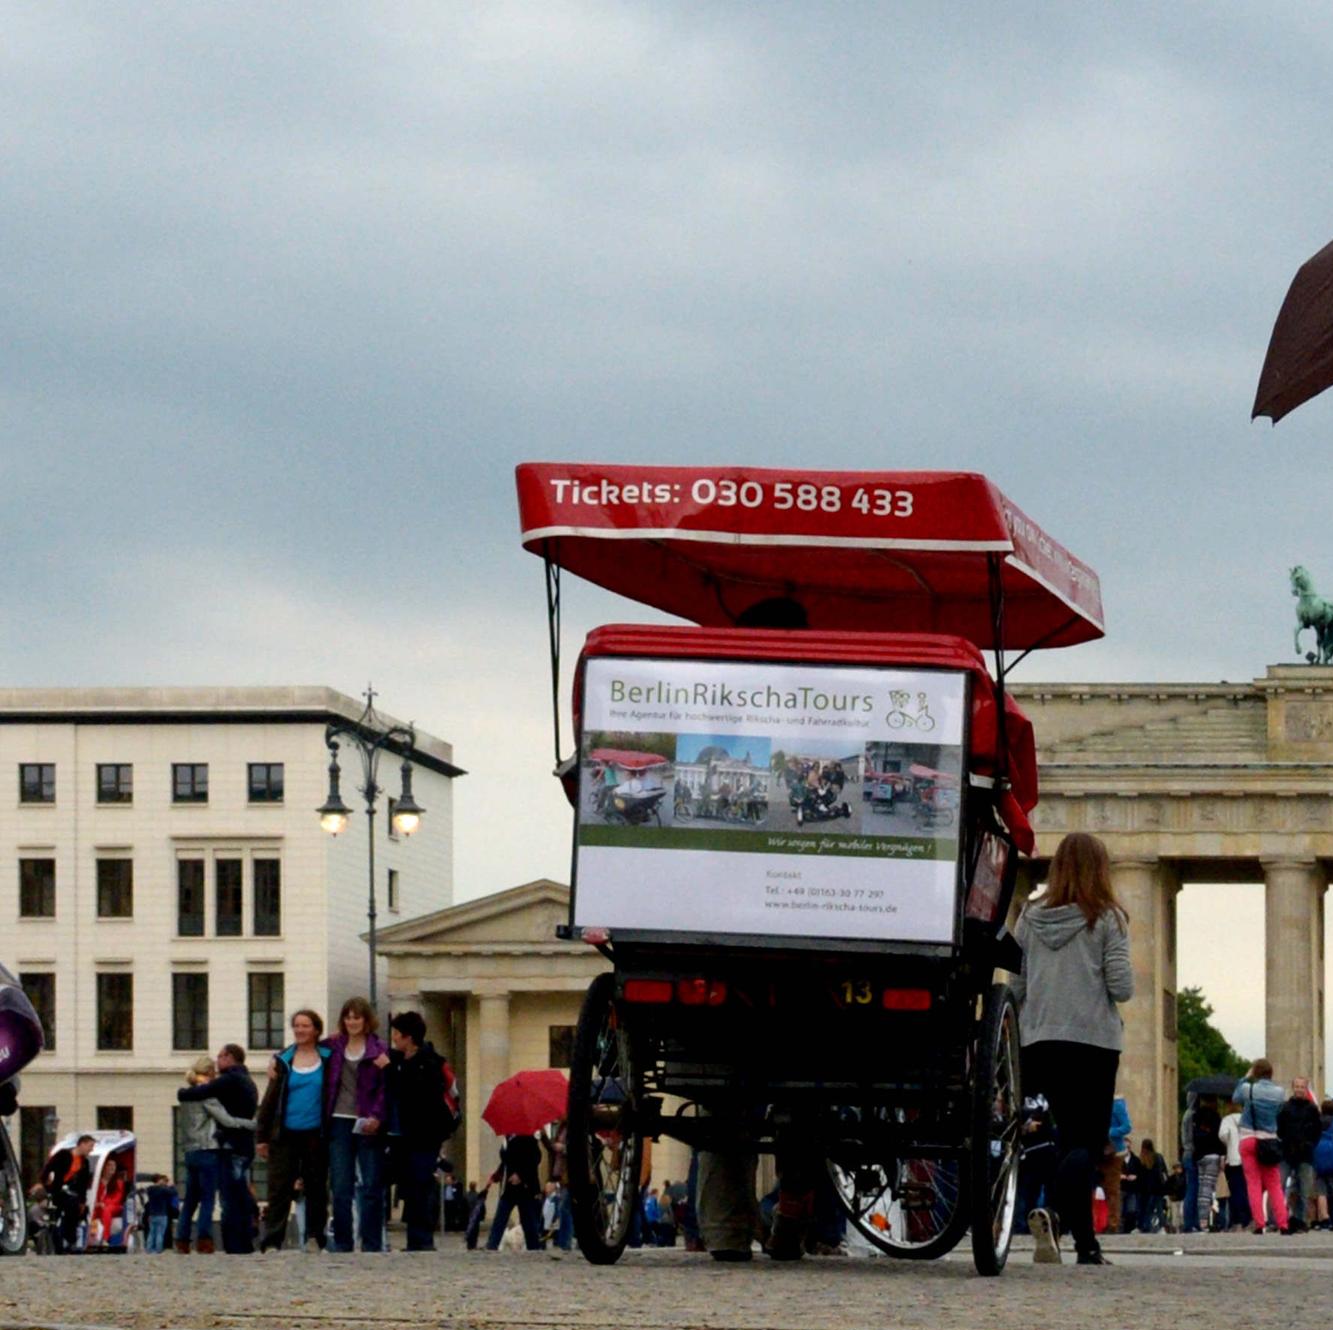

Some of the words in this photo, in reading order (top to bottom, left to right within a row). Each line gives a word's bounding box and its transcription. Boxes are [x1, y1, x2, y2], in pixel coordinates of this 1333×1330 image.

[549, 479, 680, 505] Tickets:
[691, 479, 764, 508] 030
[773, 483, 842, 513] 588
[851, 487, 914, 518] 433
[611, 680, 873, 713] BerlinRikschaTours
[841, 981, 873, 1004] 13
